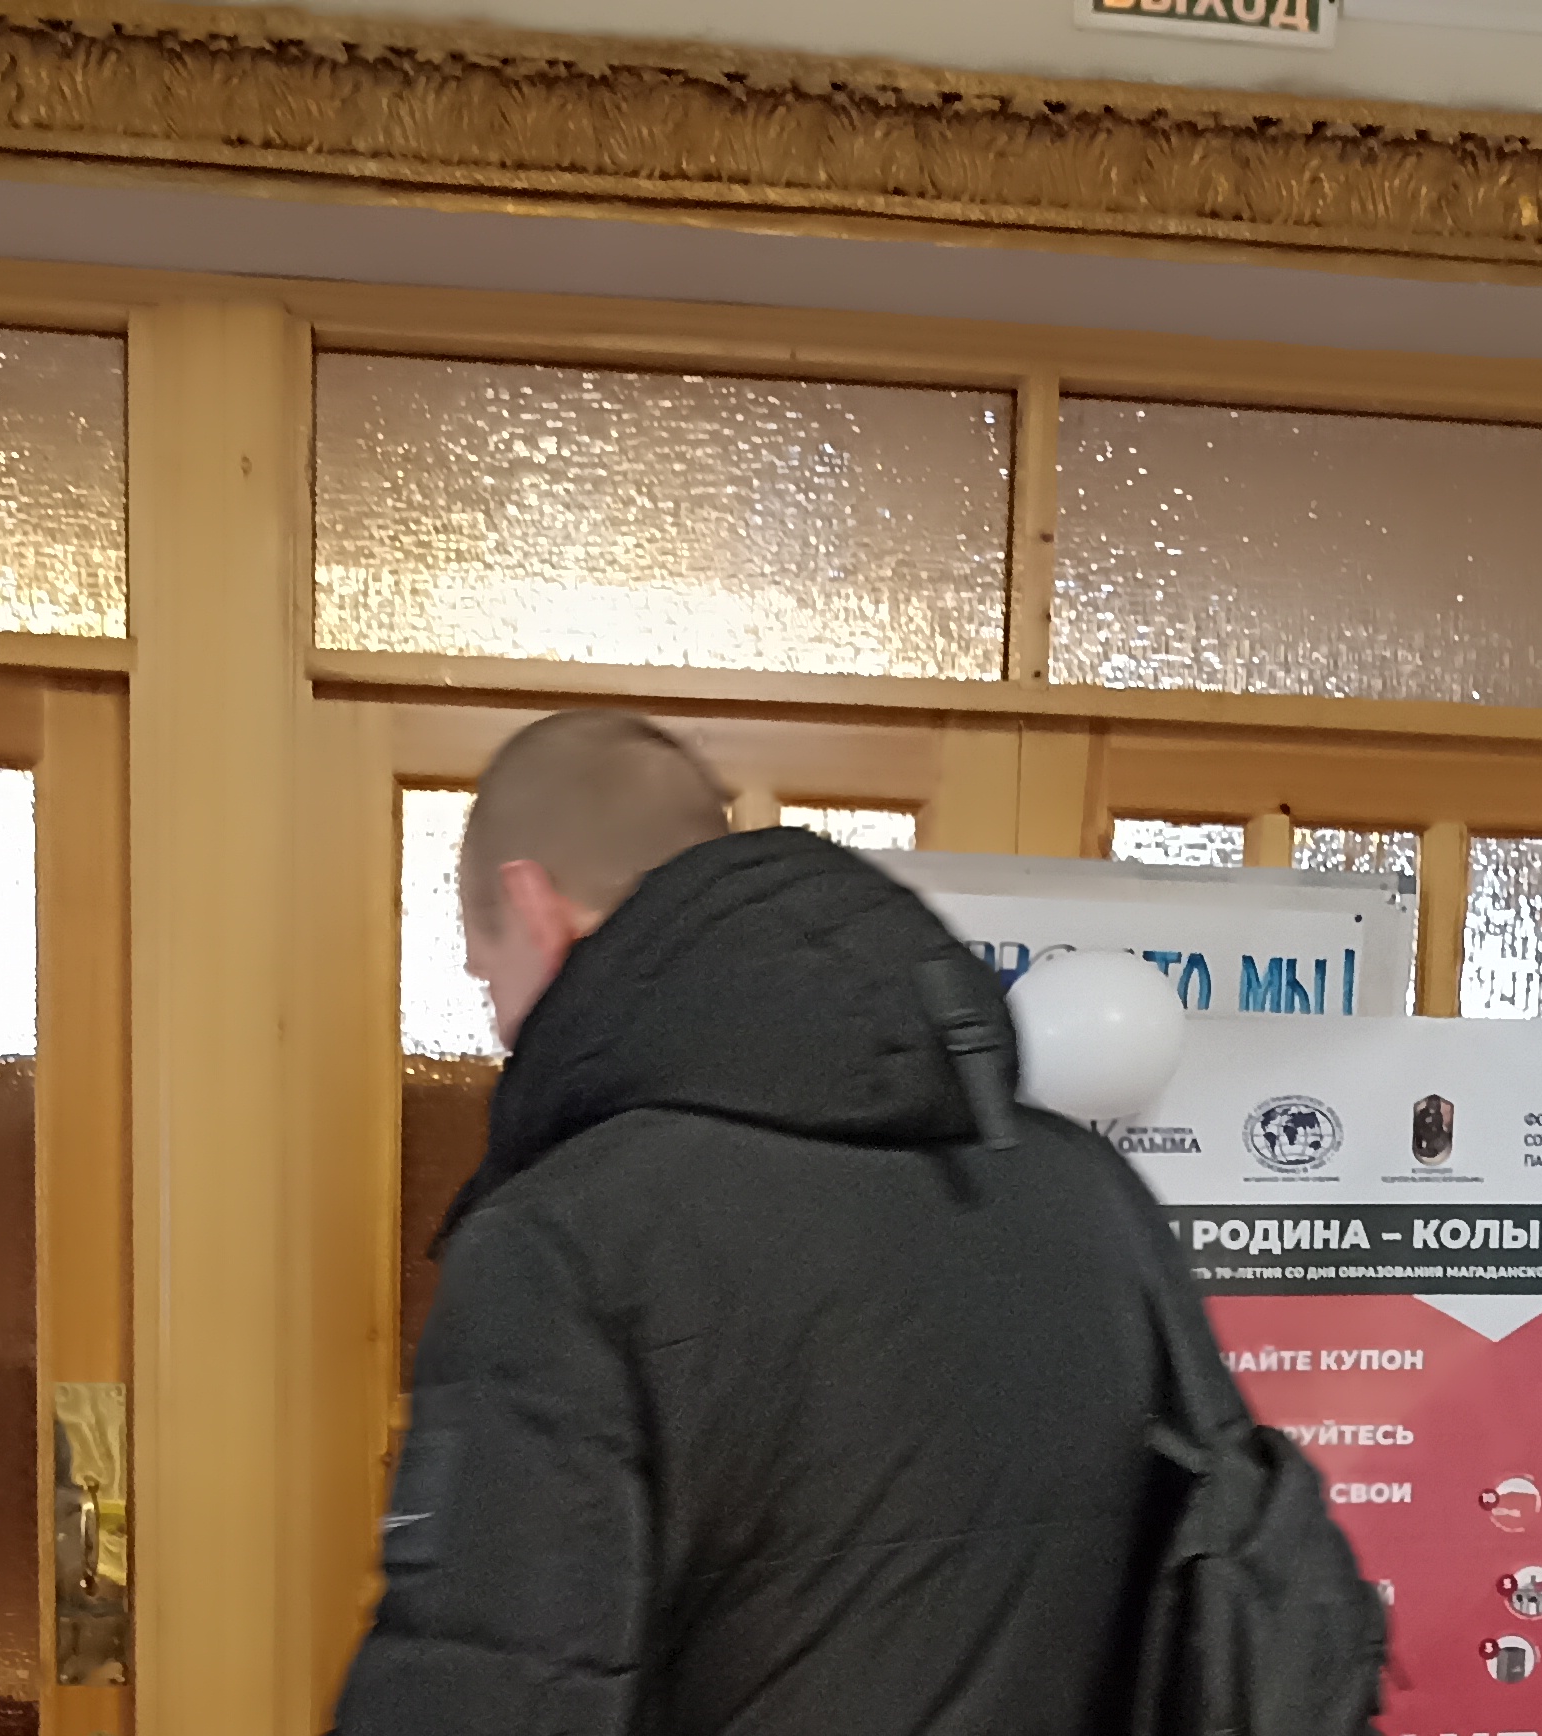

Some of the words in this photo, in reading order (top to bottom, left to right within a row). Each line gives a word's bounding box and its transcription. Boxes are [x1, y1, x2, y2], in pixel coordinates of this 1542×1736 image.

[1192, 1219, 1371, 1255] РОДИНА
[1338, 1266, 1443, 1279] ОБРАЗОВАНИЯ
[1219, 1344, 1312, 1373] ЧАЙТЕ
[1320, 1349, 1425, 1371] КУПОН
[1329, 1482, 1413, 1504] СВОИ
